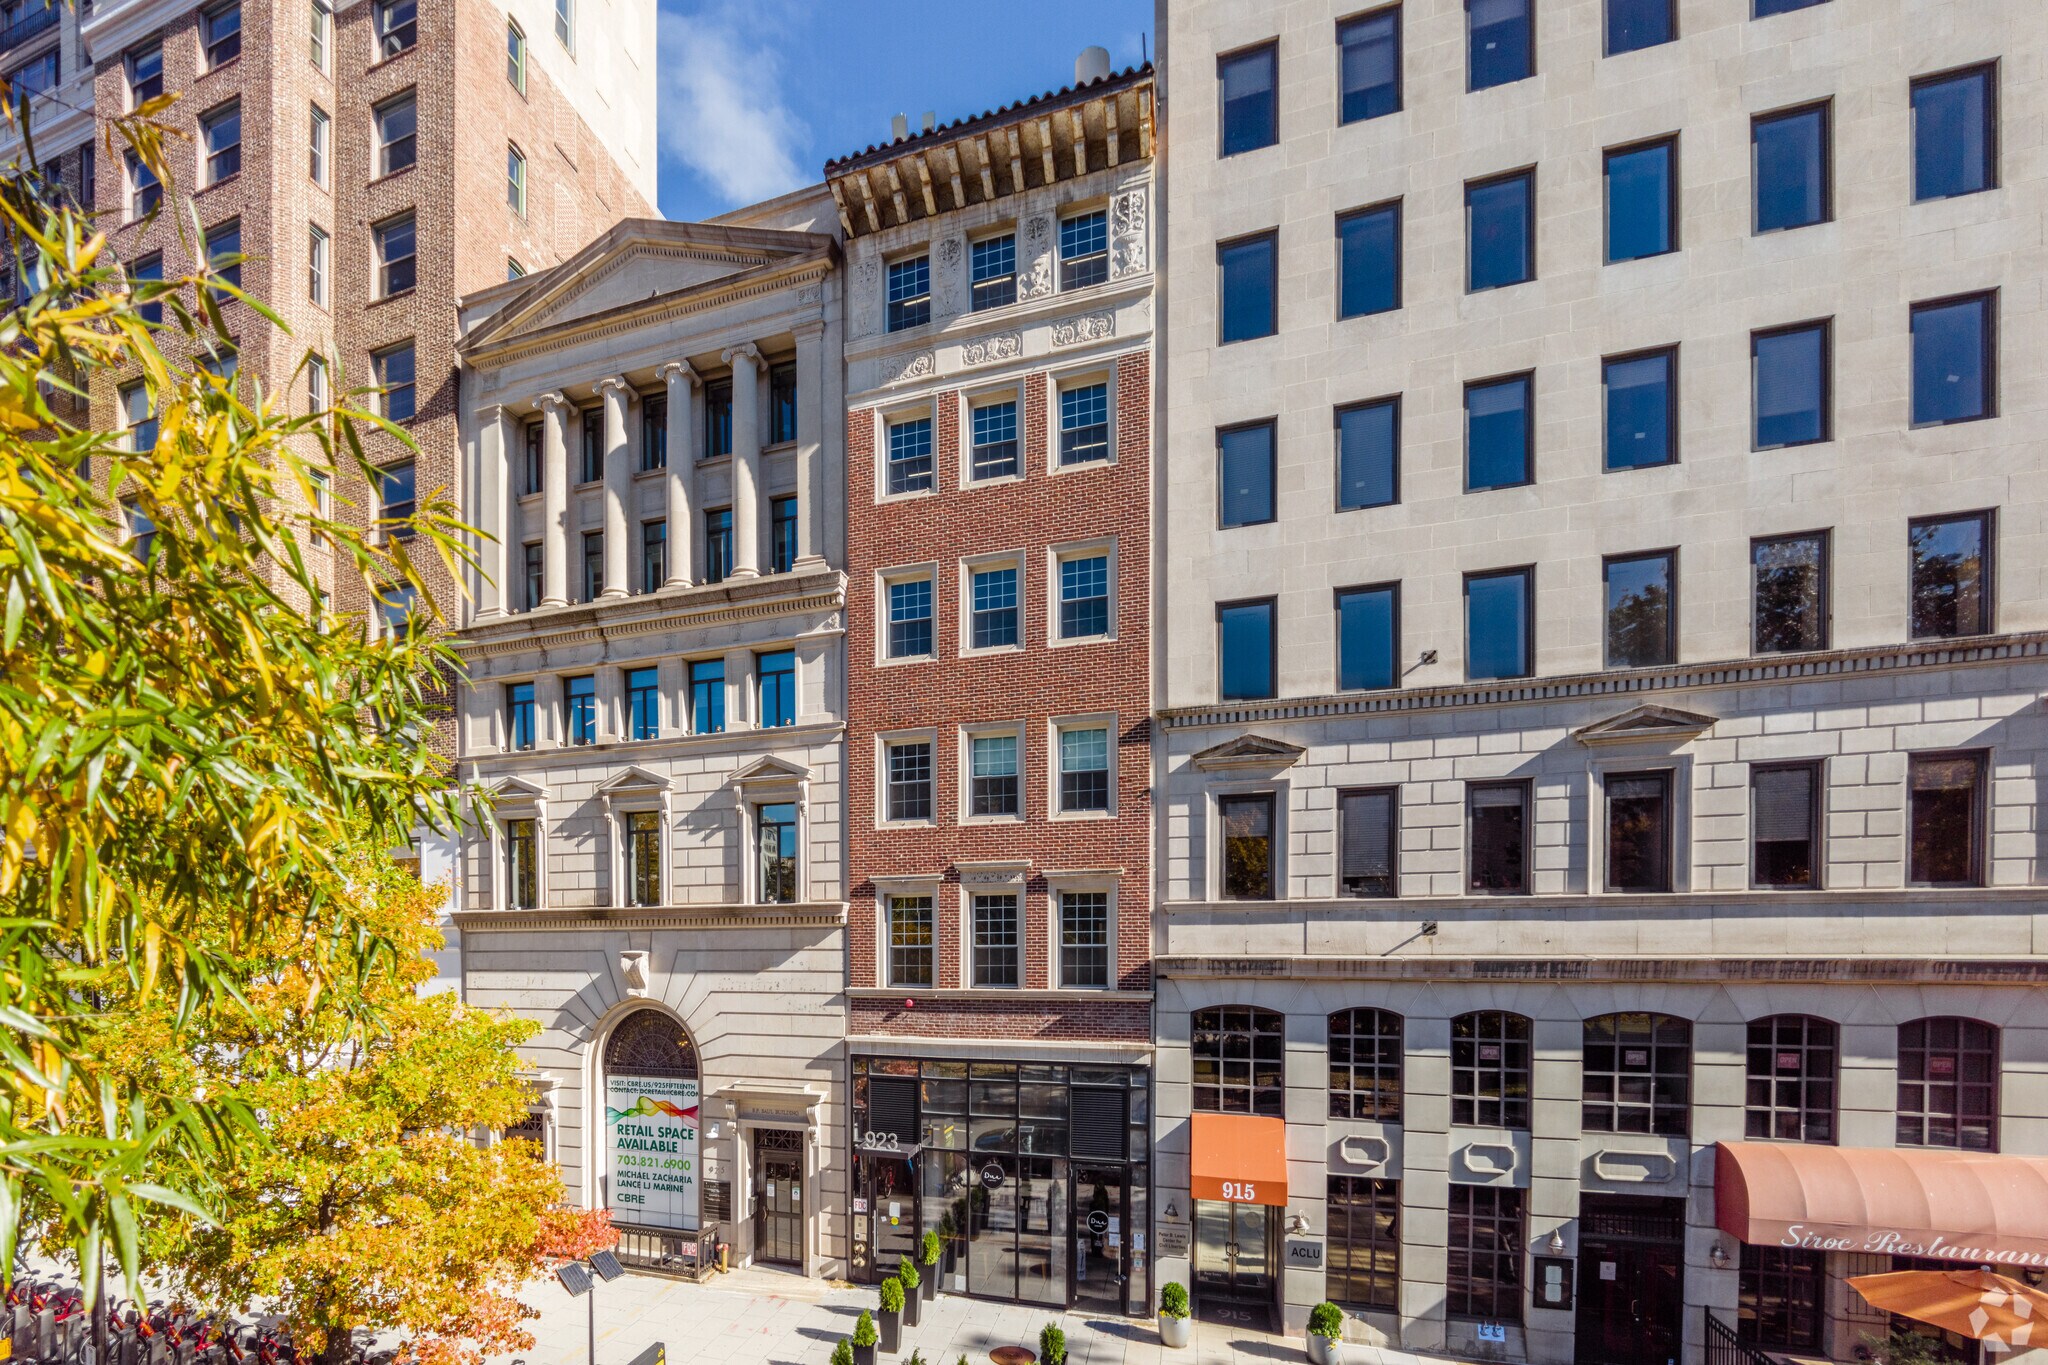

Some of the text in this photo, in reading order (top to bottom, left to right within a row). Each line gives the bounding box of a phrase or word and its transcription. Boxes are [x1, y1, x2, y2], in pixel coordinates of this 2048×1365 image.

[627, 1080, 696, 1090] CBRE.US/925FIFTEENTH
[617, 1124, 694, 1140] RETAIL SPACE
[617, 1138, 678, 1153] AVAILABLE
[865, 1131, 898, 1150] 923
[617, 1154, 691, 1171] 703.821.6900
[617, 1170, 693, 1184] MICHAEL ZACHARIA
[708, 1166, 725, 1175] 925
[617, 1180, 684, 1193] LANCE LJ MARINE
[1222, 1181, 1255, 1200] 915
[617, 1193, 645, 1204] CBRE
[855, 1201, 866, 1210] FDC
[1781, 1225, 1858, 1251] Siroc
[683, 1242, 696, 1252] FDC
[1291, 1247, 1320, 1259] ACLU
[1217, 1309, 1252, 1321] 915
